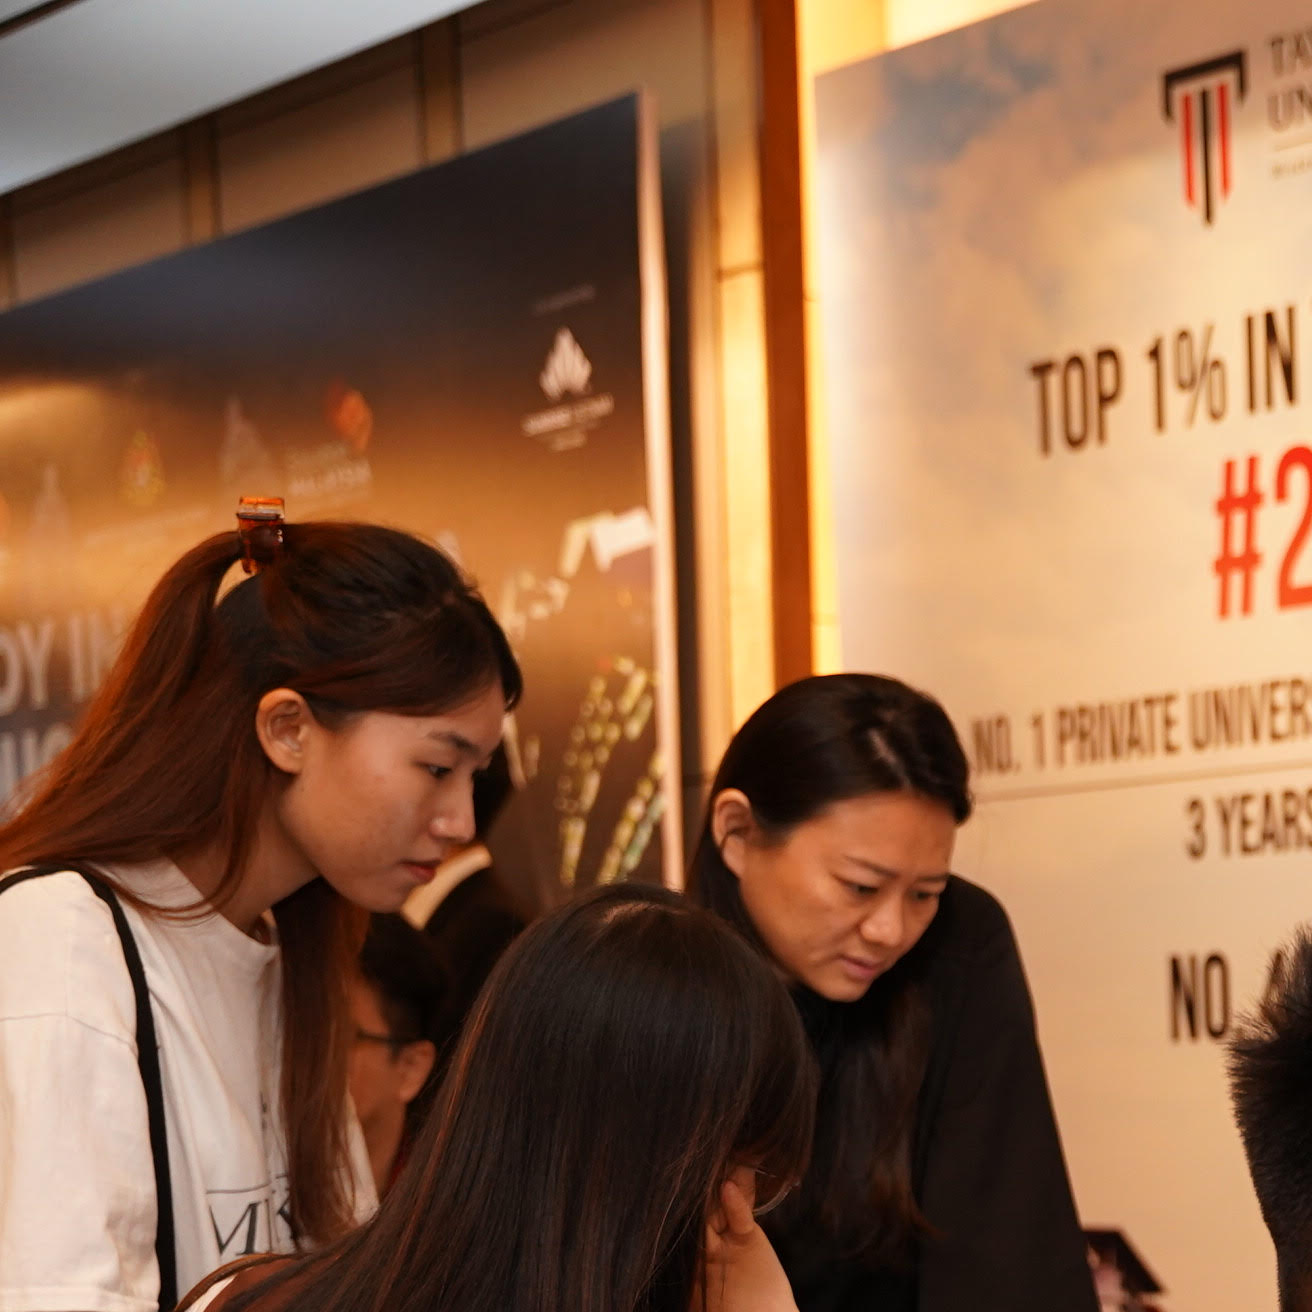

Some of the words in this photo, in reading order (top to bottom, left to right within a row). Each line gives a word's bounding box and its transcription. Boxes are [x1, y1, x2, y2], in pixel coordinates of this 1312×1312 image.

[1029, 347, 1123, 457] TOP
[1146, 324, 1228, 432] 1%
[1244, 306, 1298, 414] IN
[1031, 710, 1046, 773] 1
[1055, 692, 1181, 769] PRIVATE
[1184, 794, 1208, 861] 3
